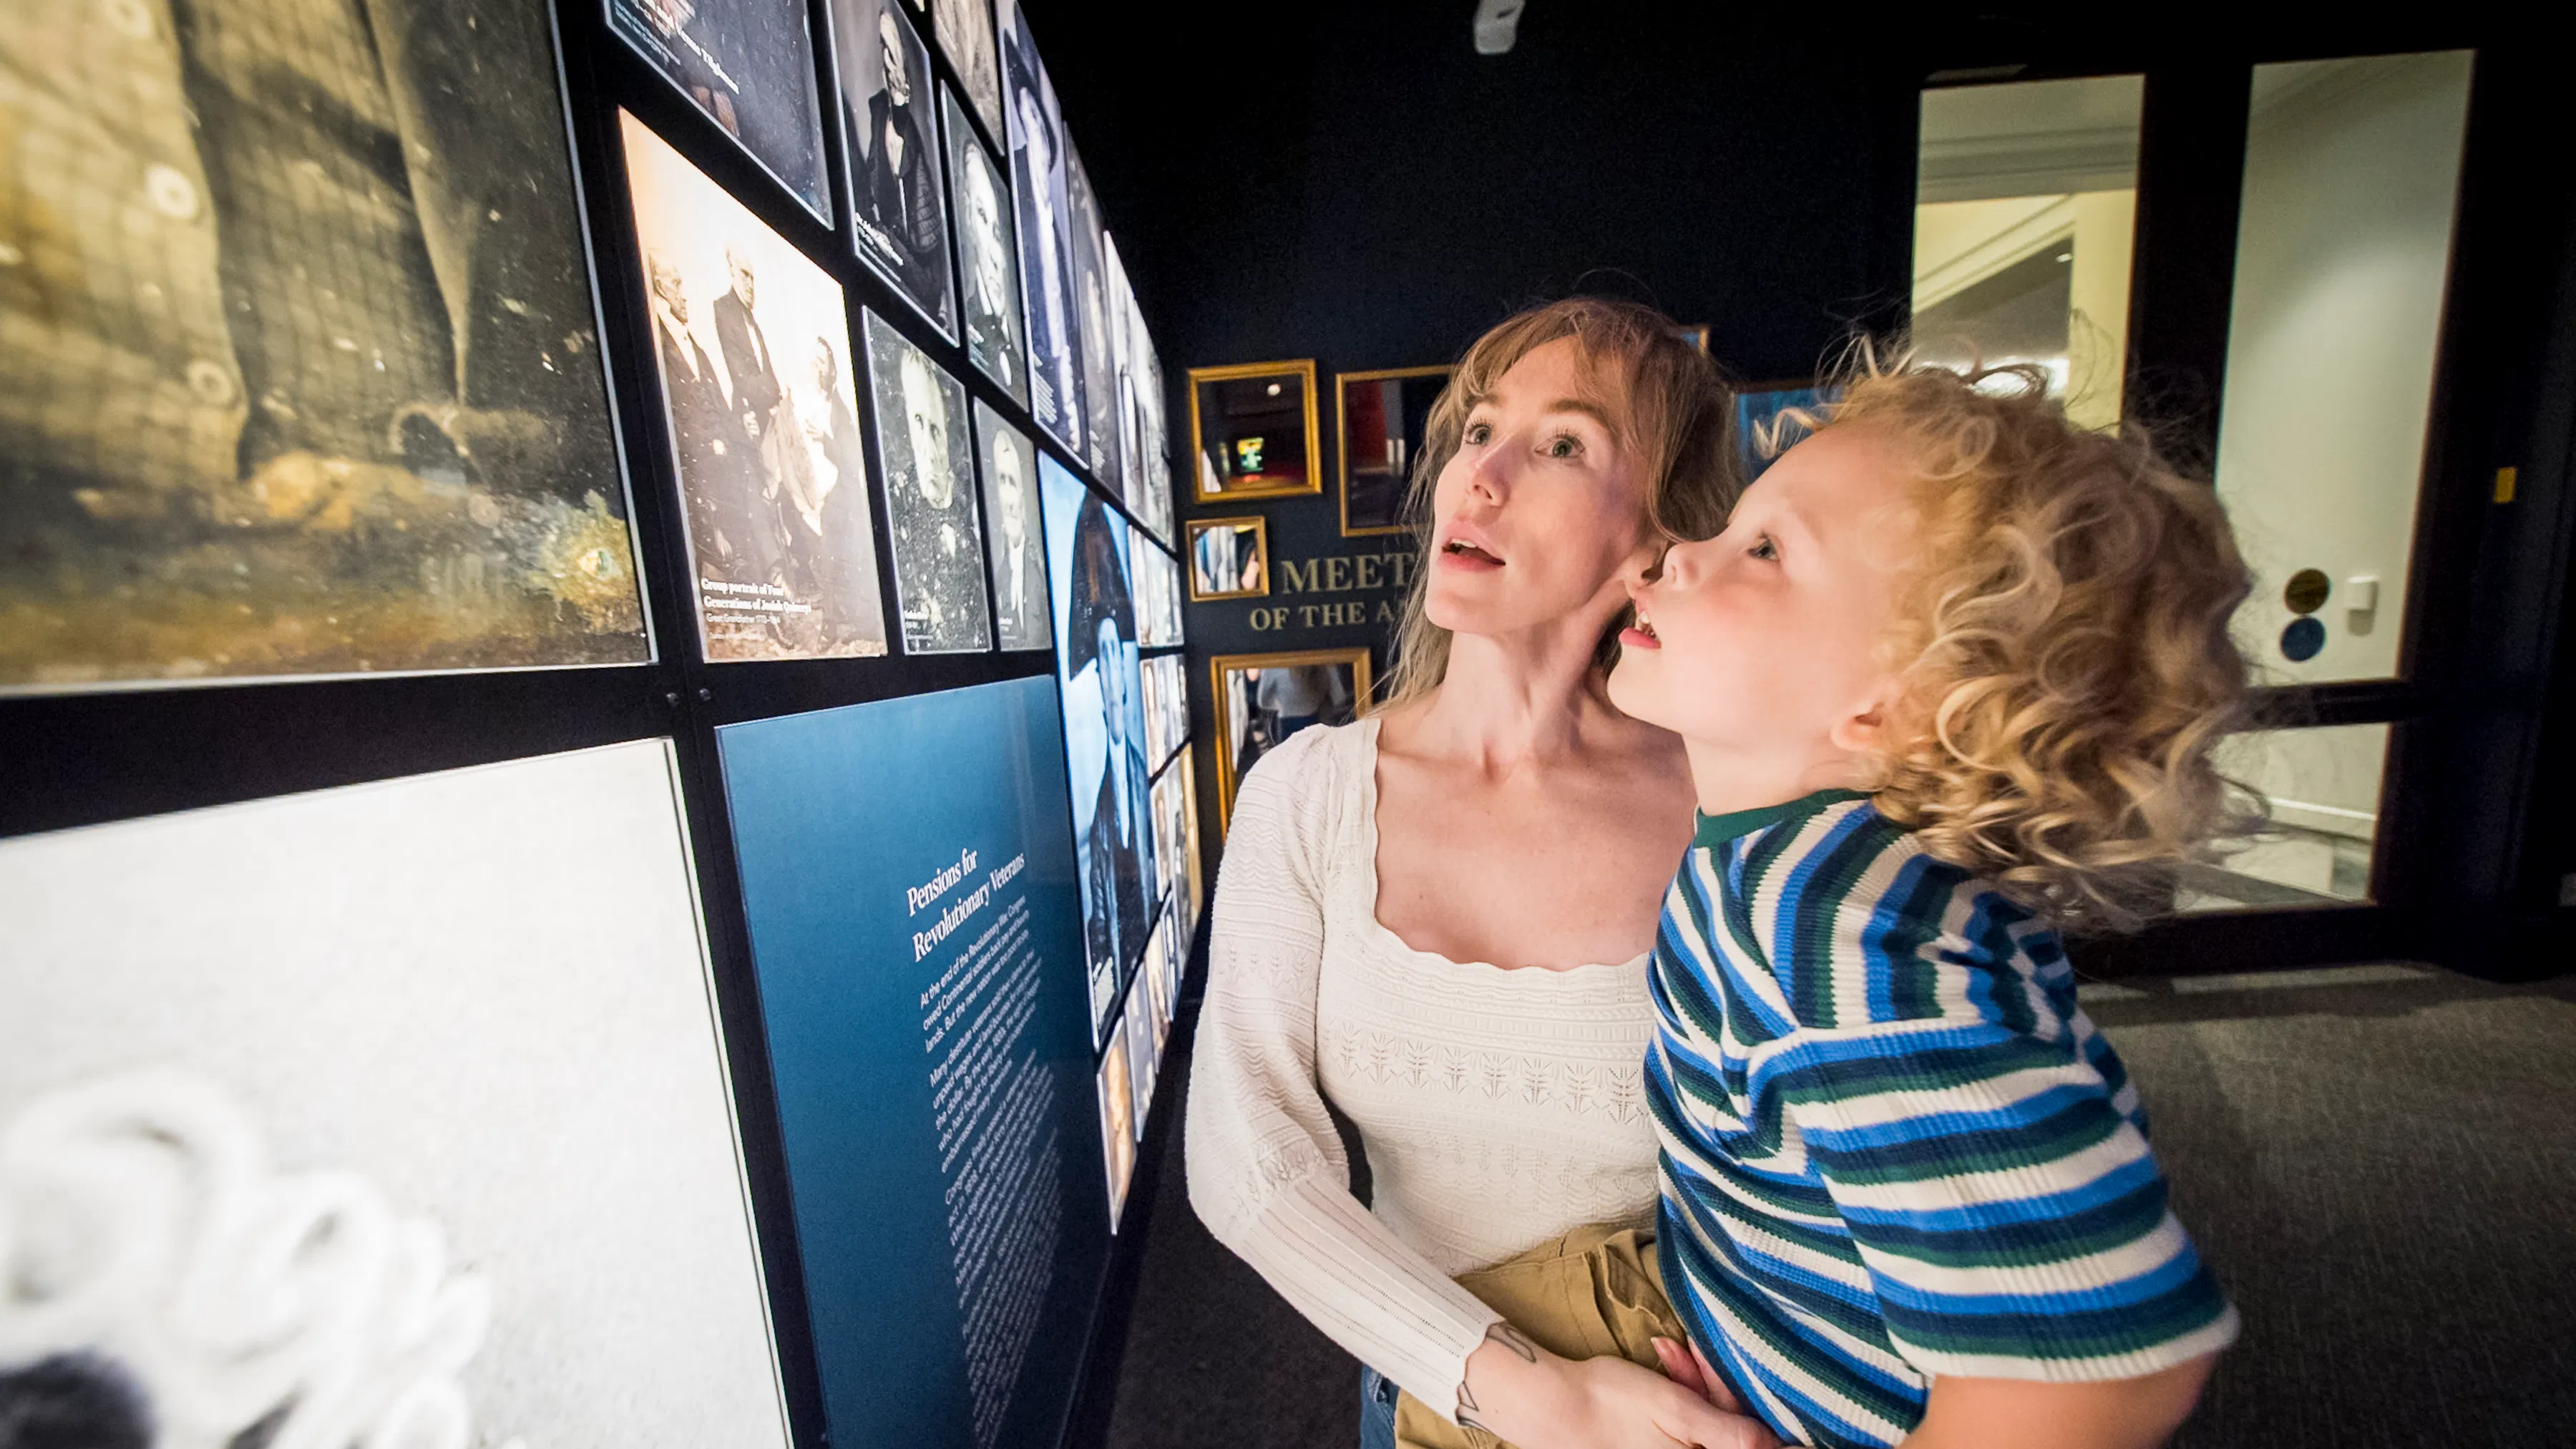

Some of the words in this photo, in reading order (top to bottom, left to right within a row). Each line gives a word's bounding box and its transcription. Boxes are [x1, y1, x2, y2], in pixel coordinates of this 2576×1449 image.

[701, 577, 728, 595] Group
[728, 582, 758, 595] portrait
[758, 583, 768, 595] of
[768, 585, 784, 596] Four
[1280, 552, 1416, 594] MEET
[703, 595, 752, 610] Generations
[752, 598, 761, 610] of
[761, 600, 784, 612] Josiah
[1249, 608, 1289, 630] OF
[1299, 601, 1366, 628] THE
[906, 862, 962, 917] Pensions
[962, 848, 977, 876] for
[912, 881, 990, 962] Revolutionary
[990, 853, 1025, 892] Veterans
[921, 992, 929, 1009] At
[929, 982, 940, 999] the
[953, 957, 959, 975] of
[960, 953, 968, 968] the
[942, 967, 972, 1010] Continental
[945, 1012, 956, 1030] But
[956, 1002, 965, 1018] the
[930, 1060, 947, 1087] Many
[936, 1111, 947, 1131] the
